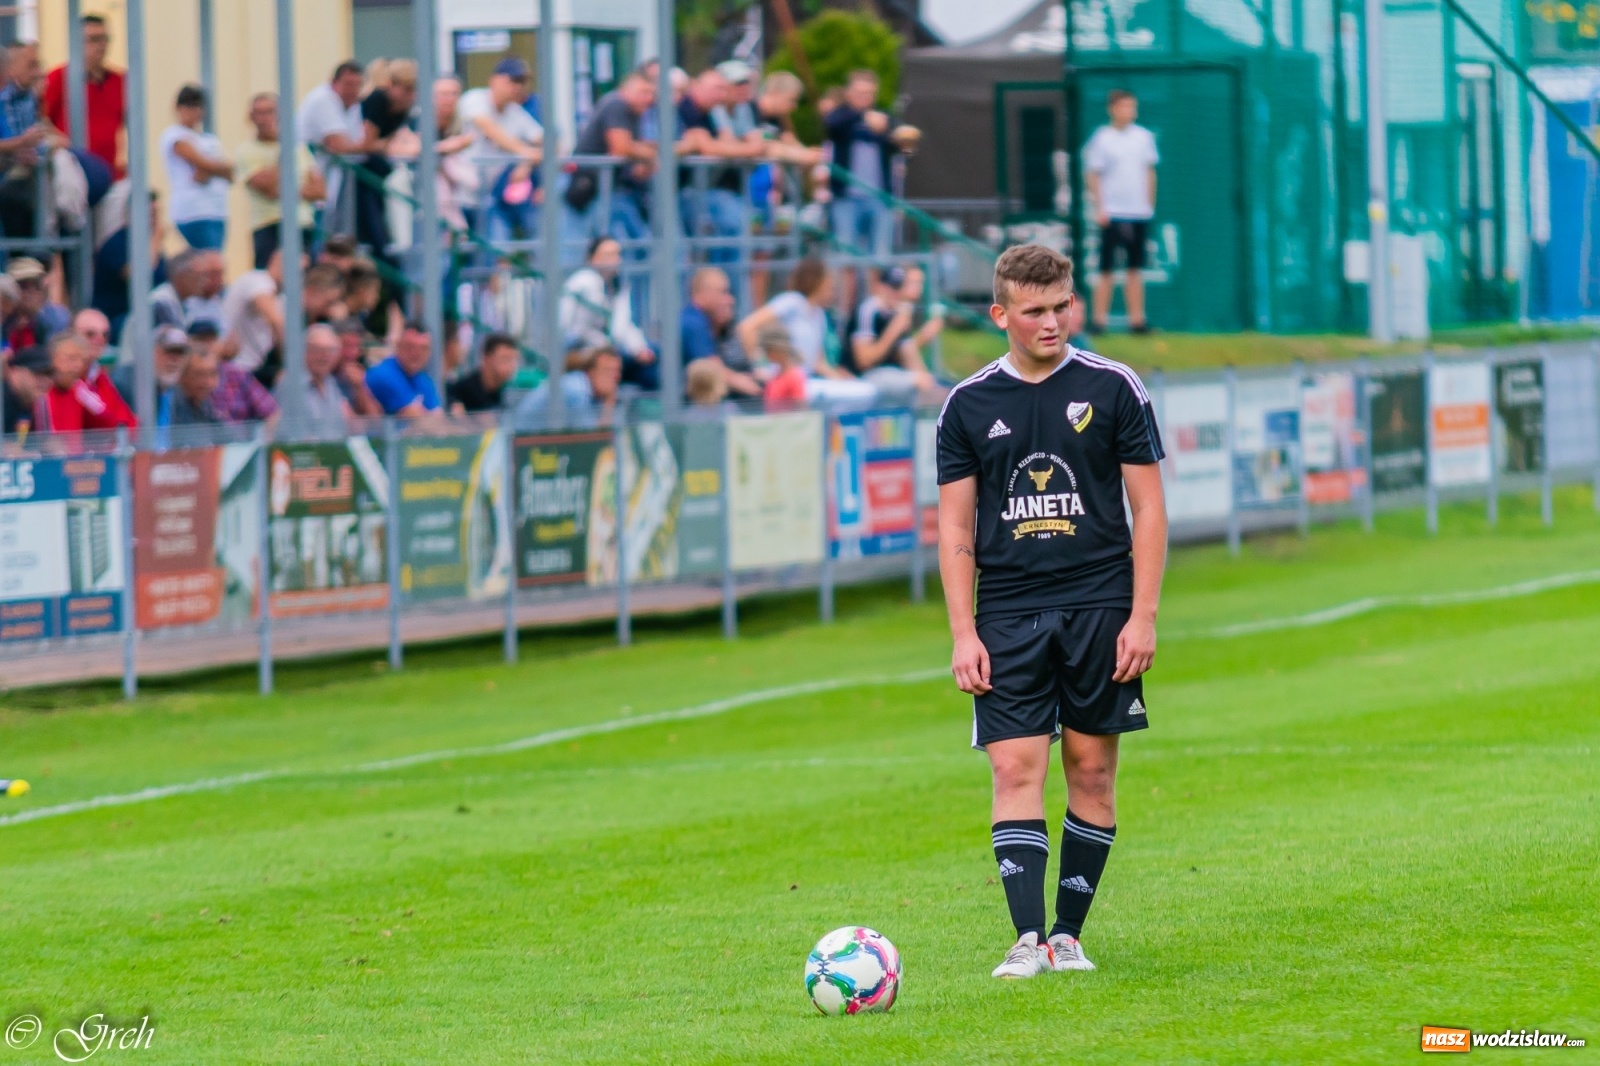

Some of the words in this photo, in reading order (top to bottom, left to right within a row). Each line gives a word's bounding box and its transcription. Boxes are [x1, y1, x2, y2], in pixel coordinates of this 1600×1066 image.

[988, 427, 1011, 438] adidas
[1007, 469, 1019, 492] ZAKŁAD
[1001, 492, 1086, 520] JANETA
[1023, 521, 1064, 530] ERNESTYN
[1060, 880, 1093, 894] adidas
